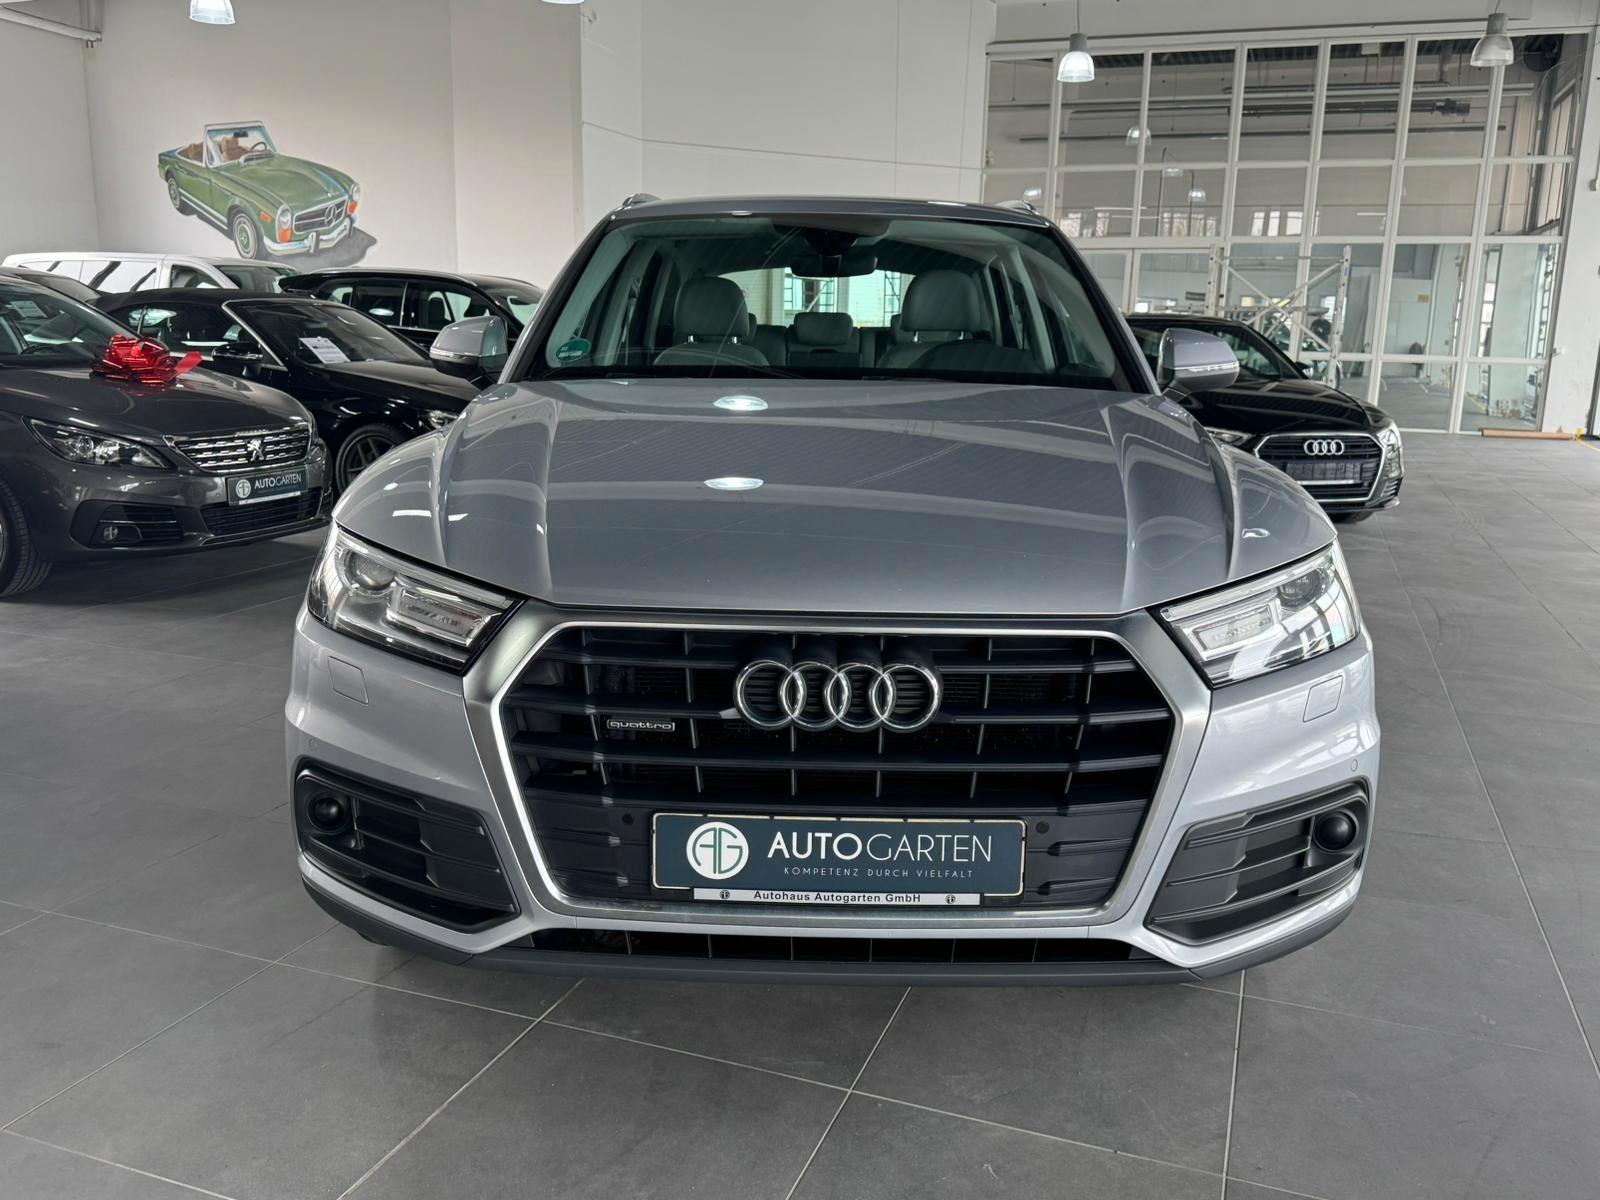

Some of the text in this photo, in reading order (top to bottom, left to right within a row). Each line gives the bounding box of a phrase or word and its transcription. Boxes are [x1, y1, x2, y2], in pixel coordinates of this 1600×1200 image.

[254, 473, 302, 489] AUTOGARTEN
[609, 721, 672, 730] quattro
[767, 831, 992, 863] AUTOGARTEN
[784, 866, 973, 879] KOMPETENZ DURCH VIELFALT
[753, 890, 921, 904] Autohaus Autogarten GmbH
